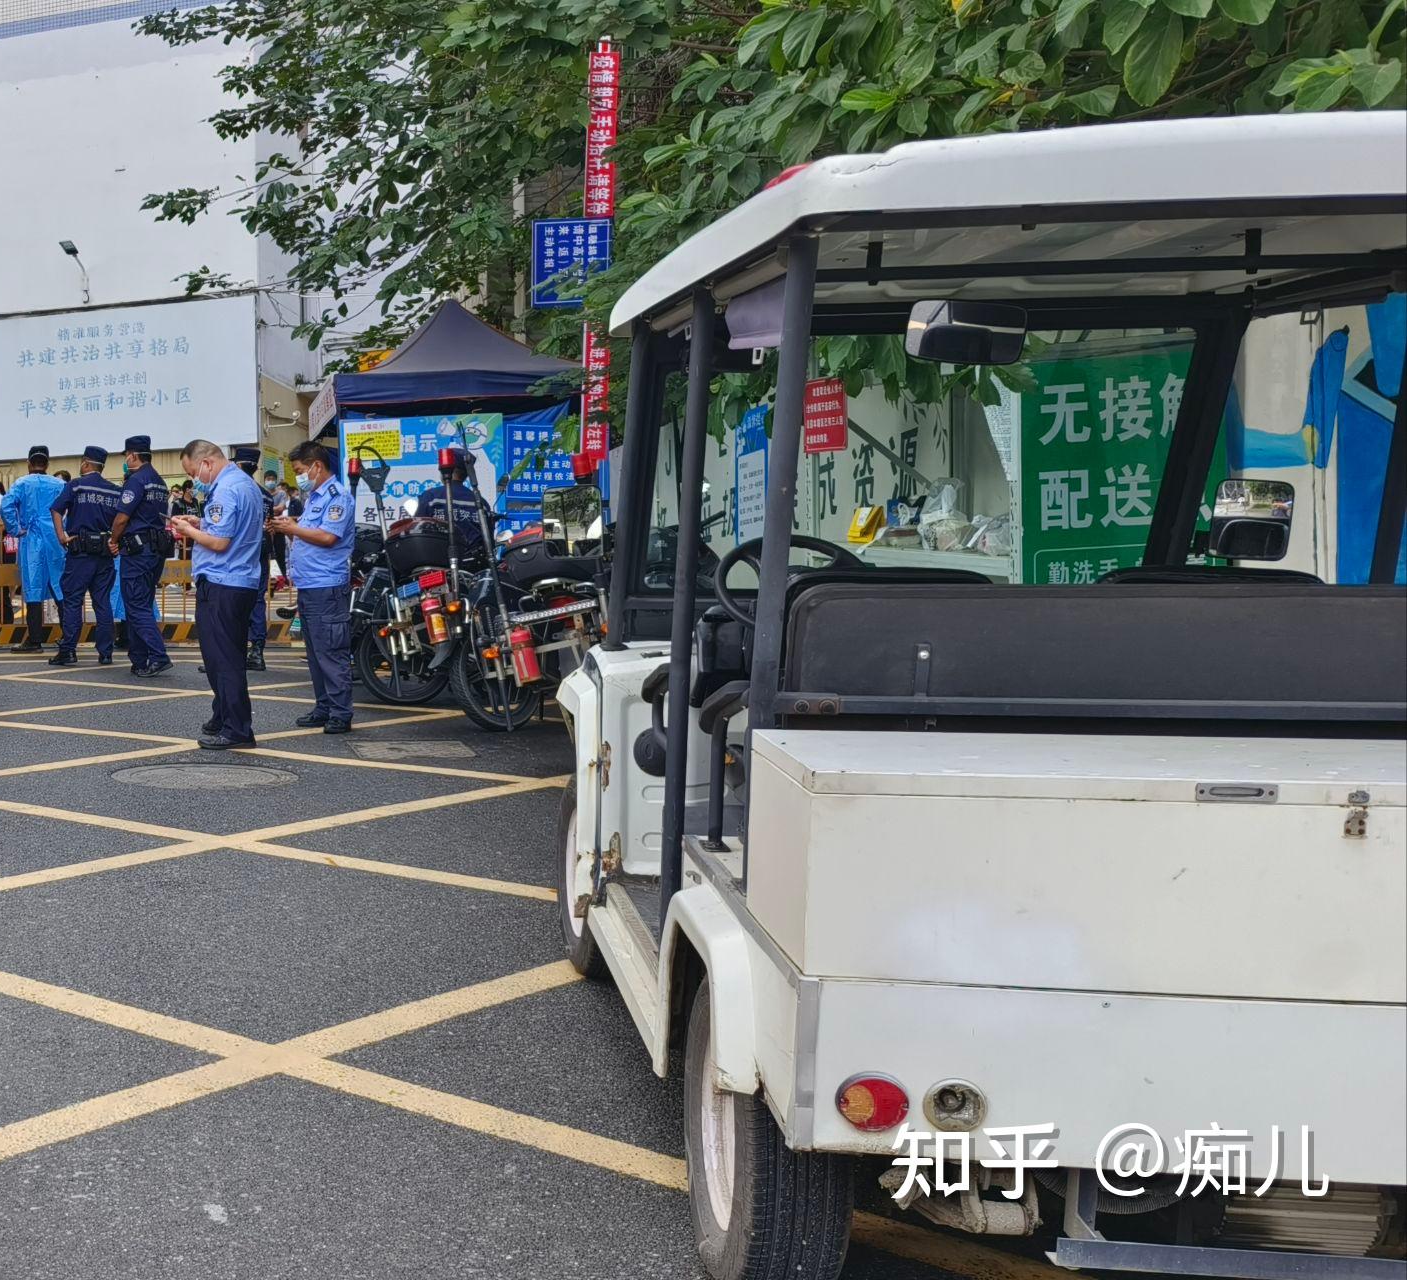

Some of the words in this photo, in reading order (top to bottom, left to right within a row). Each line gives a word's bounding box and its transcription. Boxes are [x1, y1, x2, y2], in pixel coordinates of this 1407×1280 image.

[16, 336, 190, 368] 共建共治共享格局
[18, 387, 193, 418] 平安美丽和谐小区
[515, 472, 574, 481] 瞒行程依法
